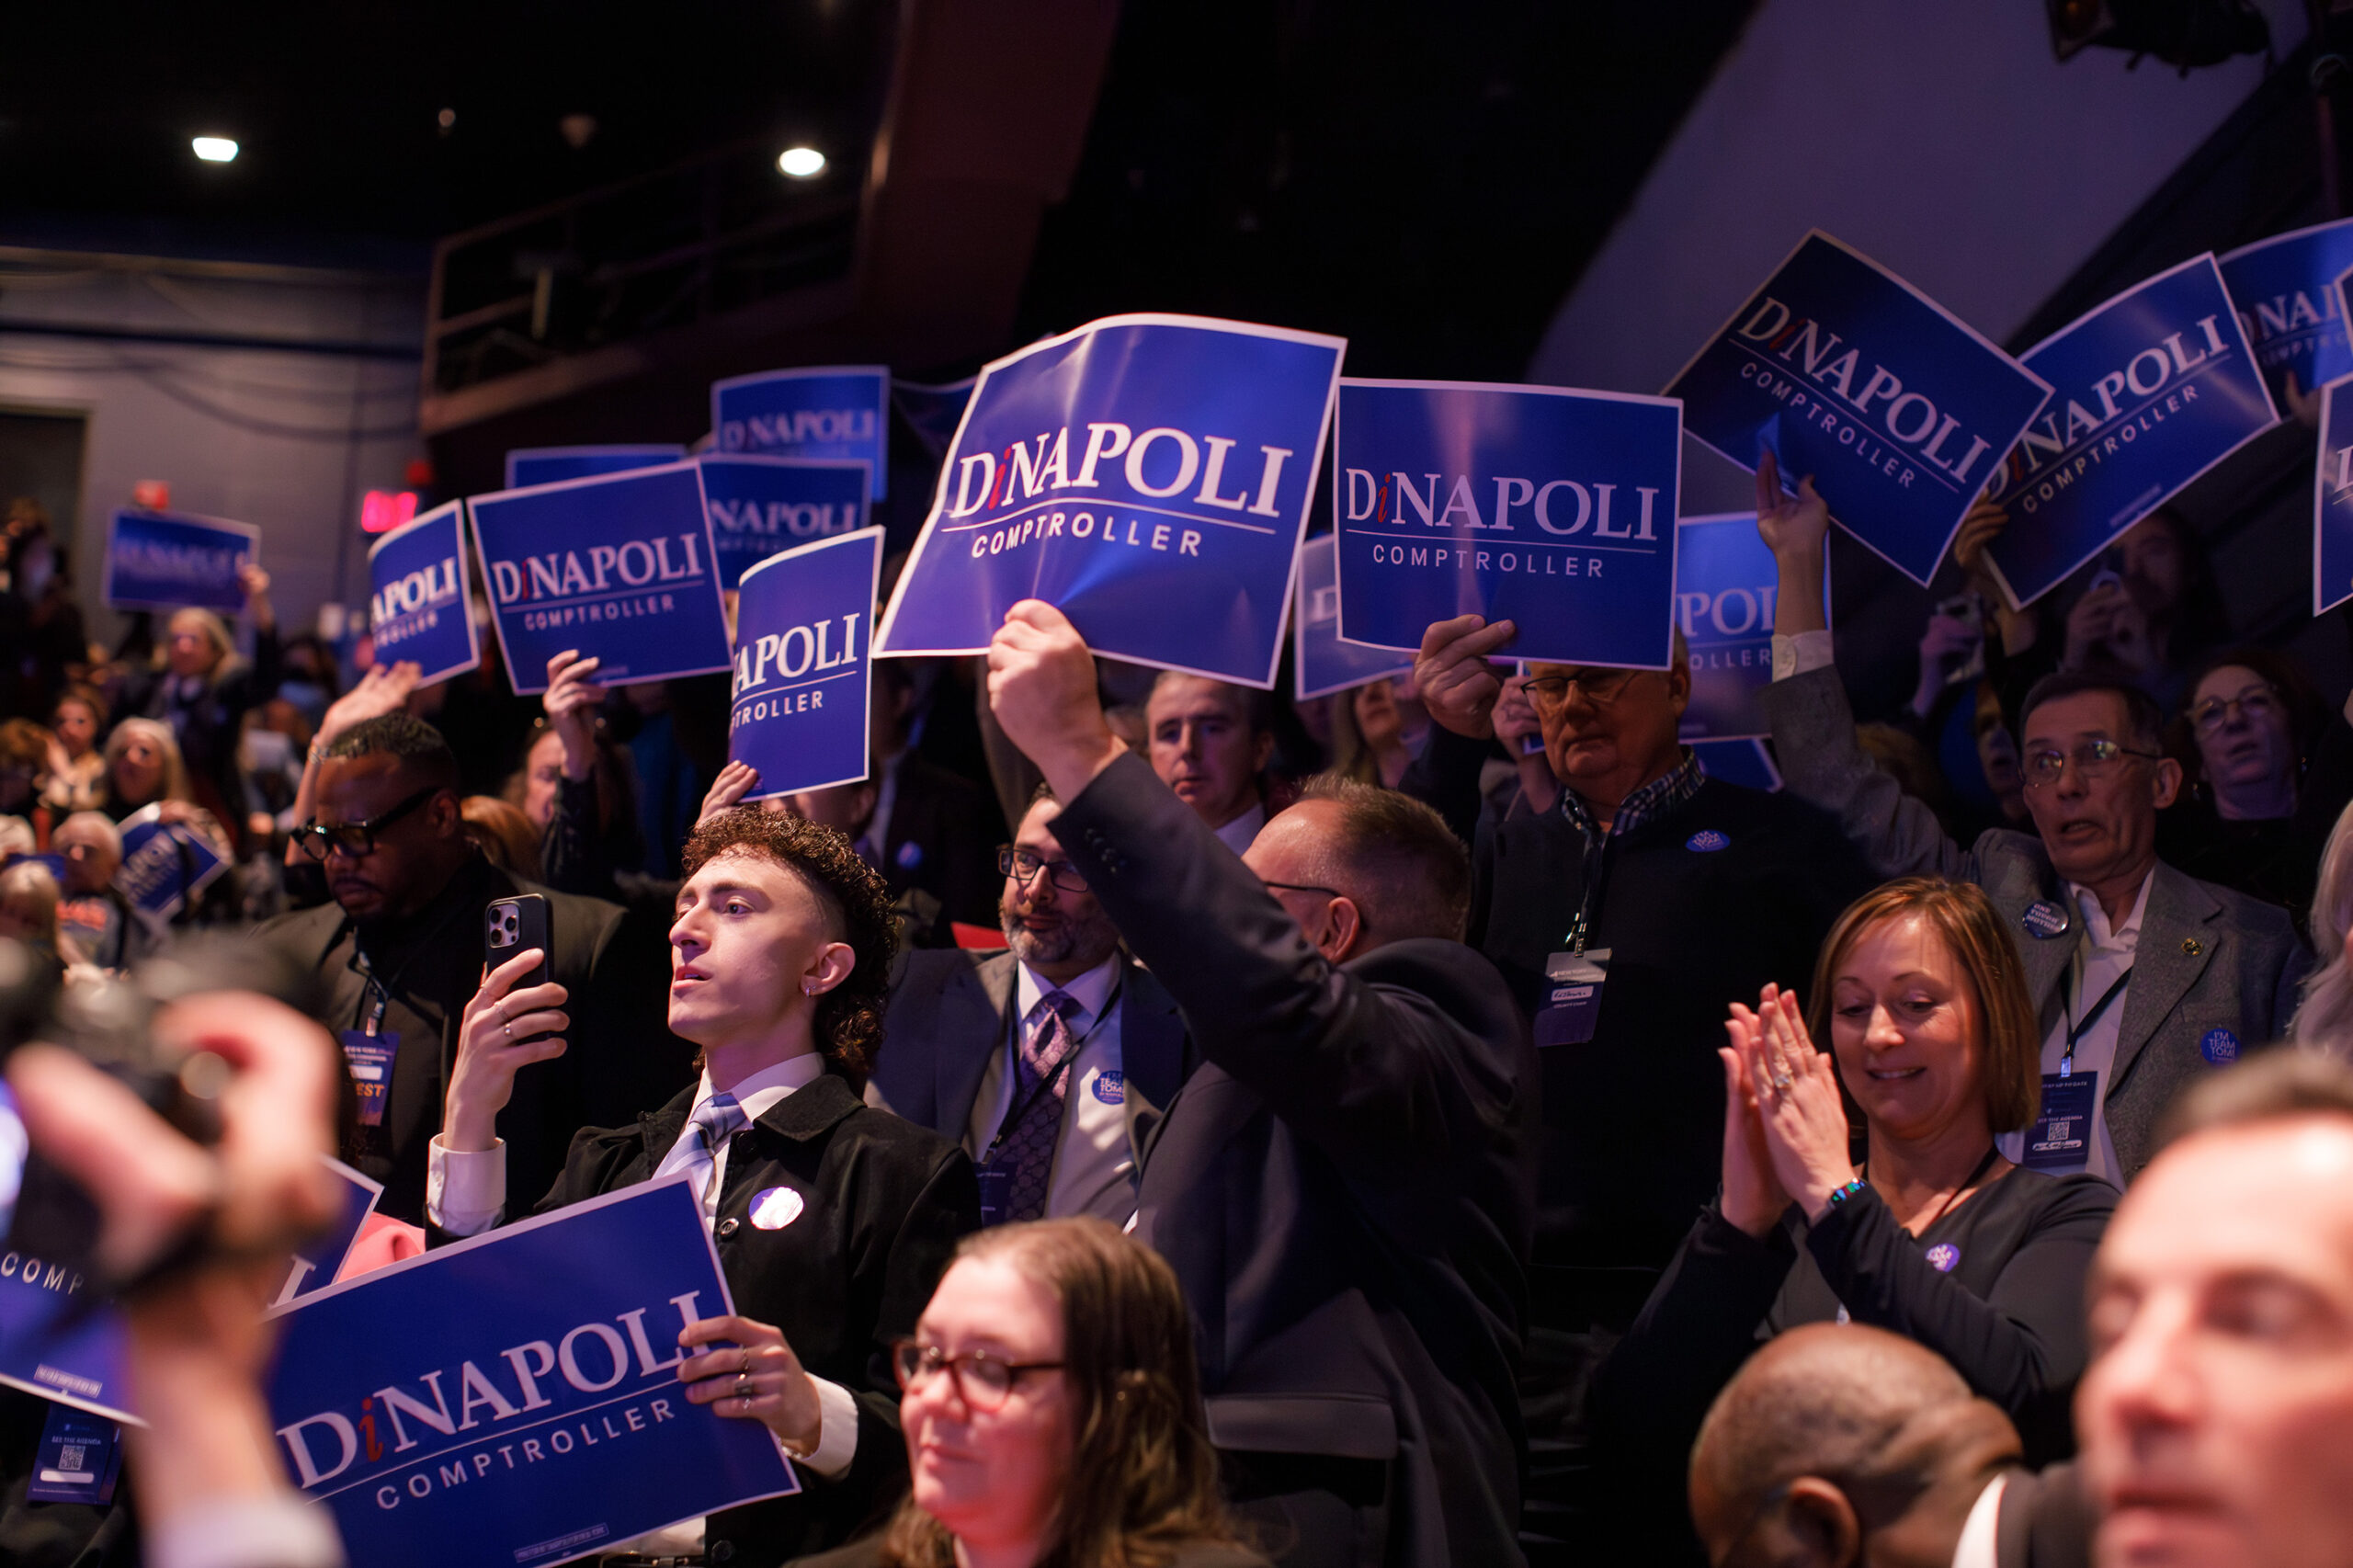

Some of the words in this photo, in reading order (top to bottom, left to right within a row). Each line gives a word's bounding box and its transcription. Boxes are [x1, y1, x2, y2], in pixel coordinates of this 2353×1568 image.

[1737, 296, 1992, 485] DiNAPOLI
[1740, 361, 1915, 489] COMPTROLLER
[949, 422, 1293, 519] DiNAPOLI
[2023, 384, 2200, 513] COMPTROLLER
[971, 511, 1202, 559] COMPTROLLER
[1346, 467, 1660, 540] DiNAPOLI
[491, 532, 705, 605] DiNAPOLI
[1372, 543, 1604, 578] COMPTROLLER
[524, 593, 676, 631] COMPTROLLER
[733, 612, 861, 701] APOLI
[277, 1290, 711, 1489] DiNAPOLI
[375, 1398, 676, 1510] COMPTROLLER
